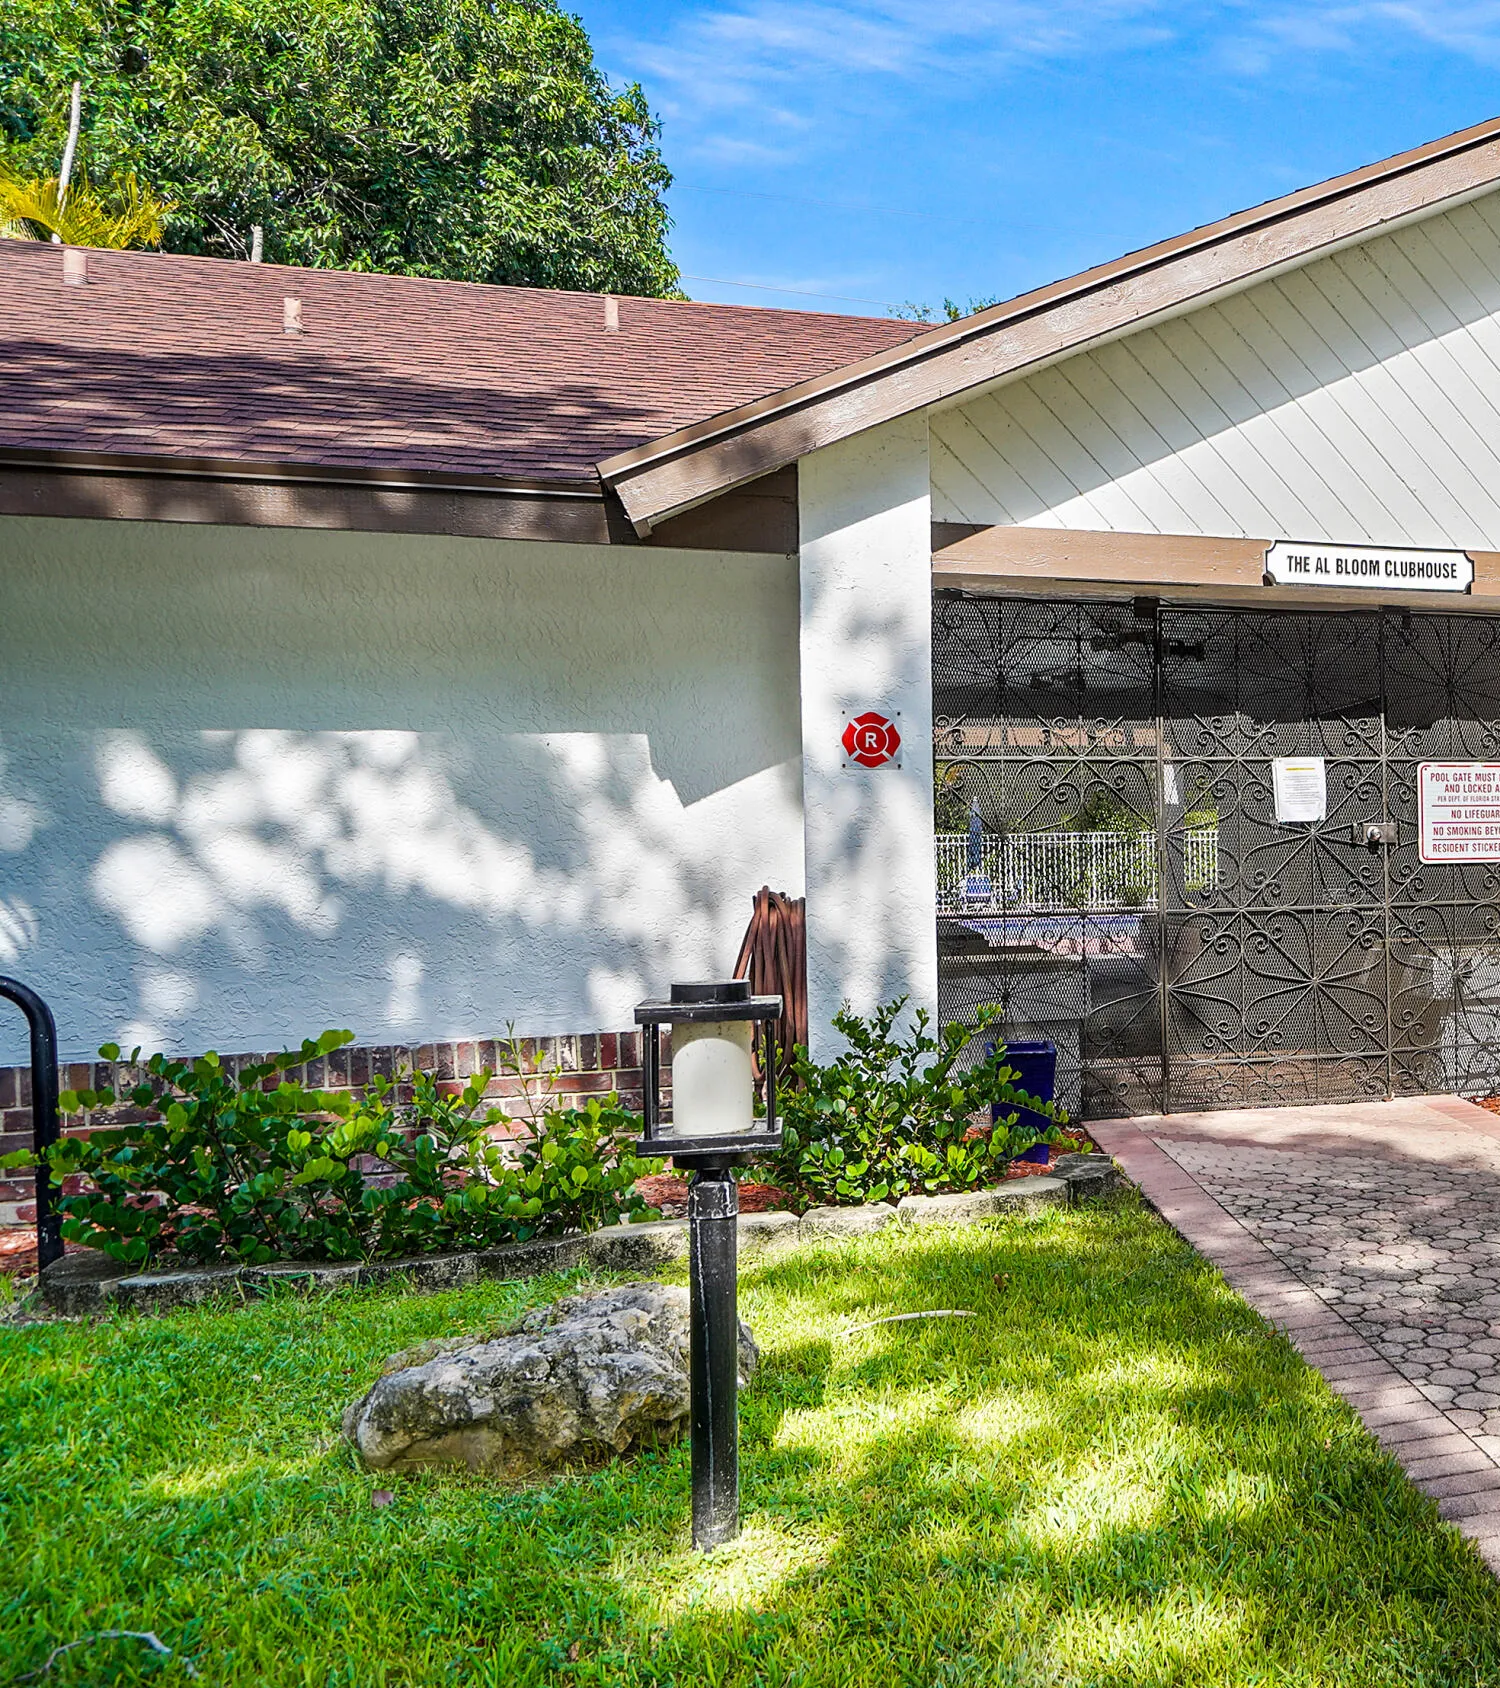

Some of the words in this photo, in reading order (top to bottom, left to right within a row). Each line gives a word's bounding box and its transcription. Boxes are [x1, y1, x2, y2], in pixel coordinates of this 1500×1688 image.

[1287, 555, 1310, 573] THE
[1315, 557, 1330, 574] AL
[1336, 558, 1380, 576] BLOOM
[1385, 560, 1457, 579] CLUBHOUSE
[865, 732, 878, 748] R
[1430, 773, 1449, 782] POOL
[1453, 773, 1472, 782] GATE
[1475, 773, 1496, 782] MUST
[1445, 784, 1460, 793] AND
[1463, 784, 1492, 793] LOCKED
[1451, 810, 1462, 819] NO
[1433, 827, 1444, 836] NO
[1447, 826, 1482, 836] SMOKING
[1432, 843, 1468, 852] RESIDENT
